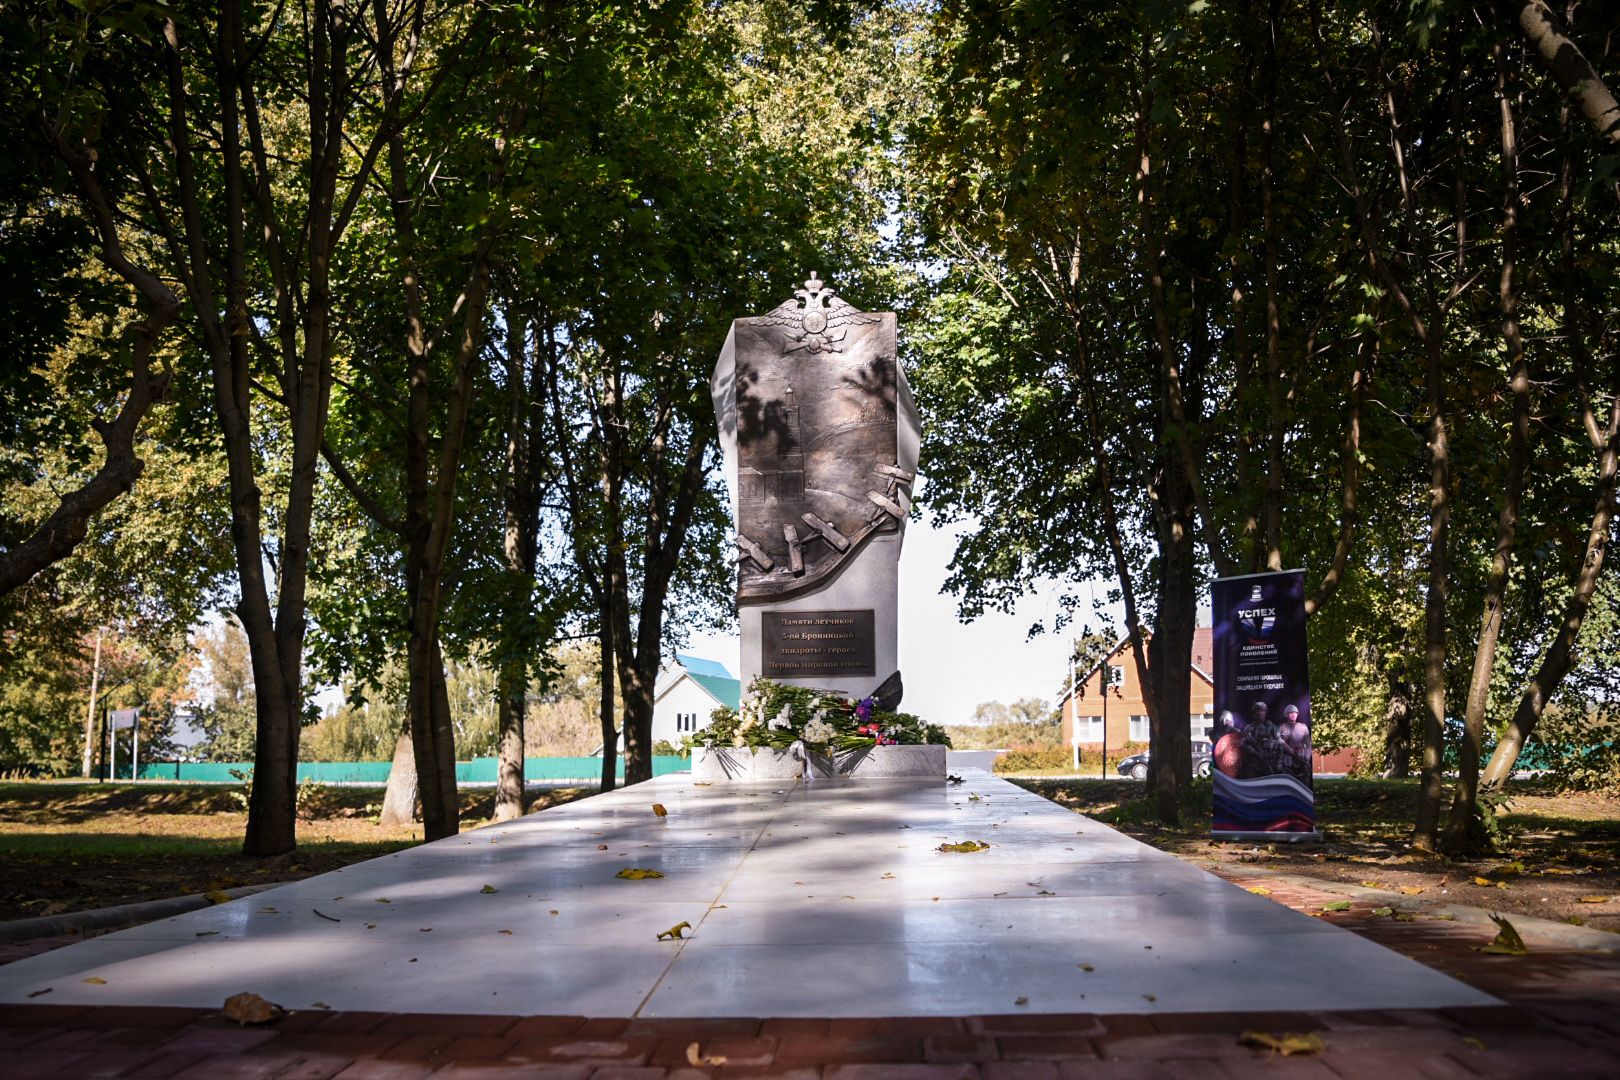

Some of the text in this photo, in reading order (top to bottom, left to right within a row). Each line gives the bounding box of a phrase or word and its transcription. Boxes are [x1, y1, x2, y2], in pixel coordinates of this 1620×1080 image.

[1238, 607, 1276, 619] УСПЕХ
[801, 632, 855, 641] Бронницкой
[1240, 649, 1278, 657] ПОКОЛЕНИЙ
